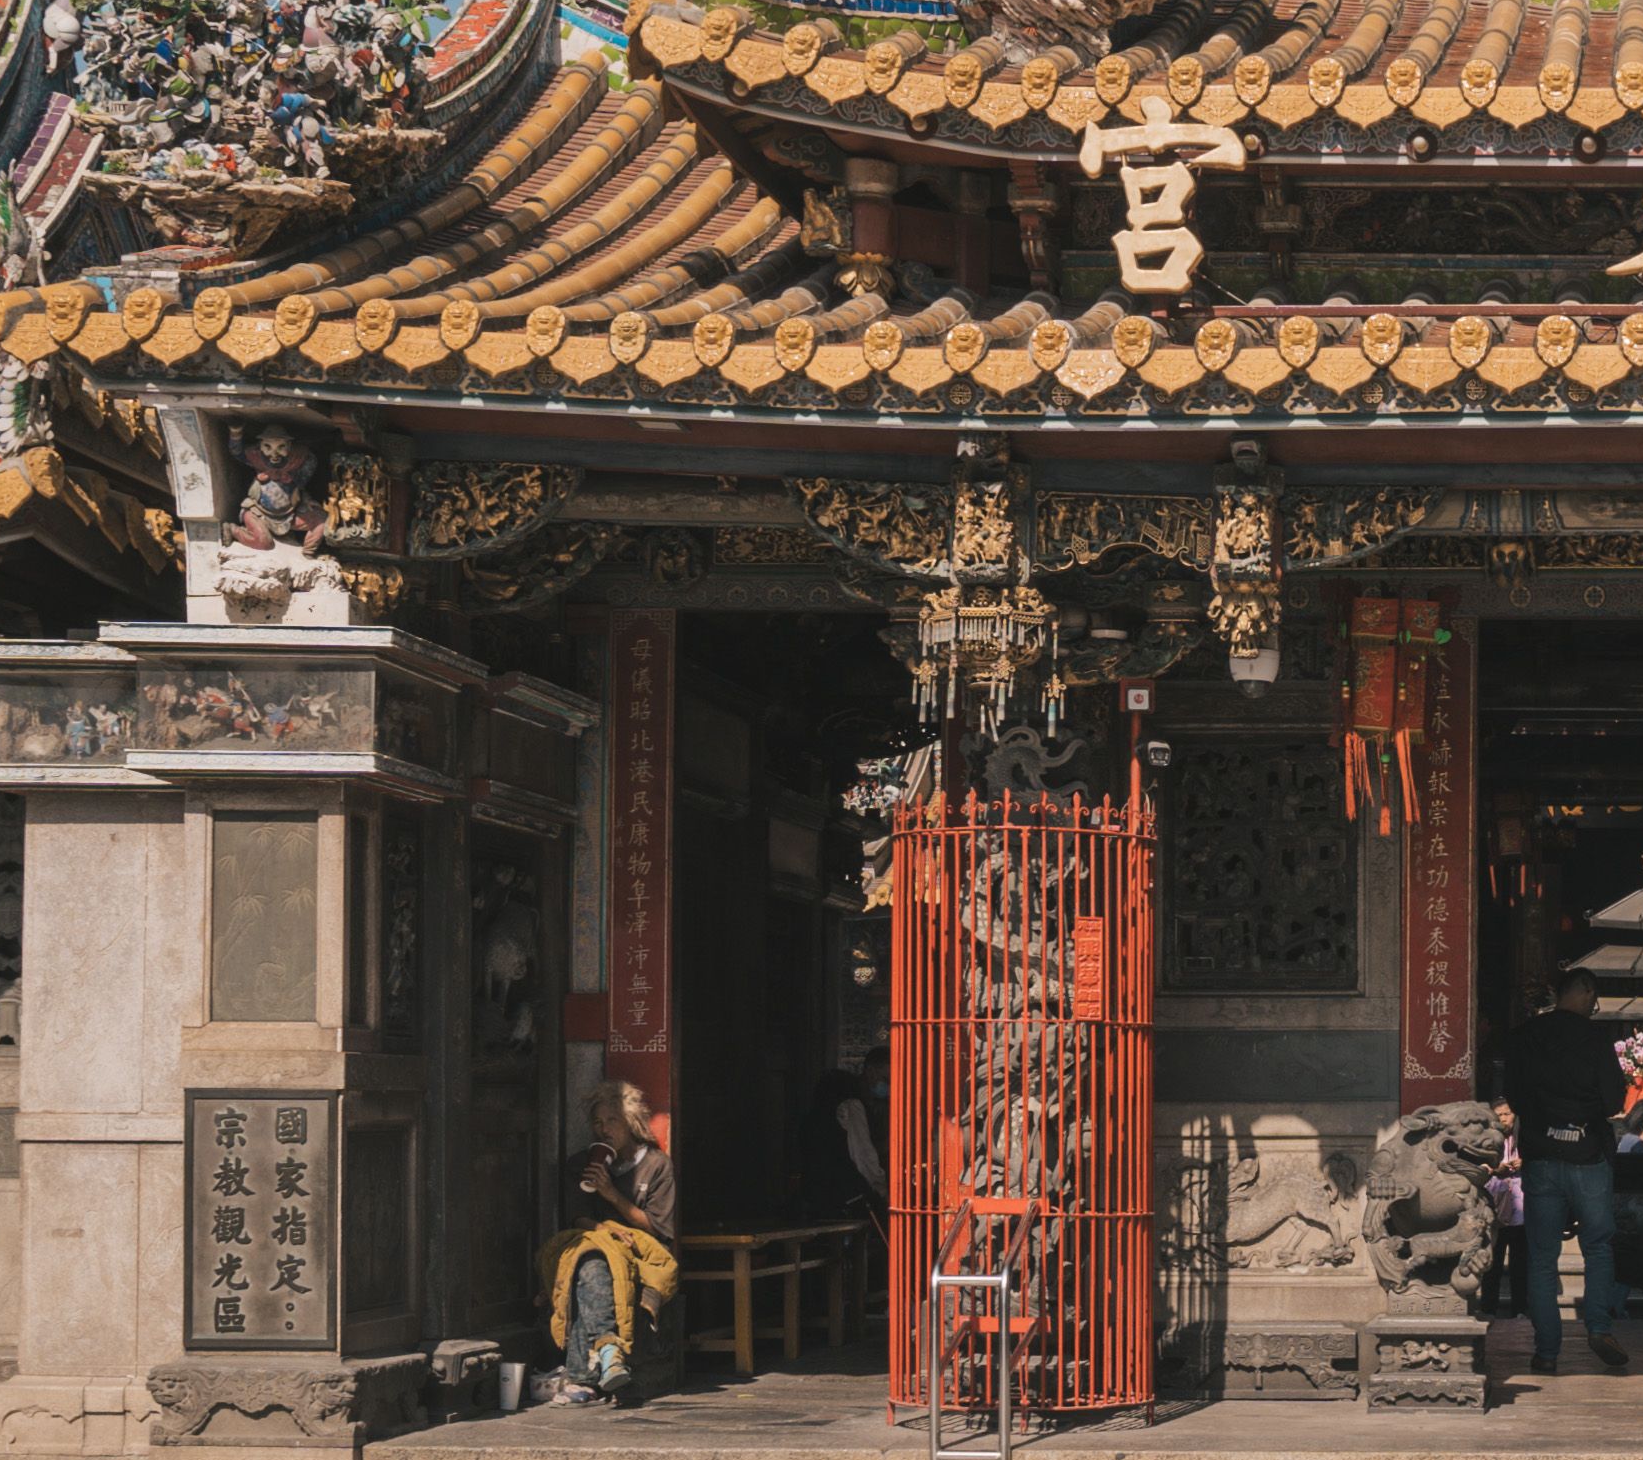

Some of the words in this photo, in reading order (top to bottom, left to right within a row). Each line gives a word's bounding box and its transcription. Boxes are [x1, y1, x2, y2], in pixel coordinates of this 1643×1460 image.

[1546, 1126, 1580, 1143] PUMA
[211, 1106, 256, 1334] 宗教觀光區
